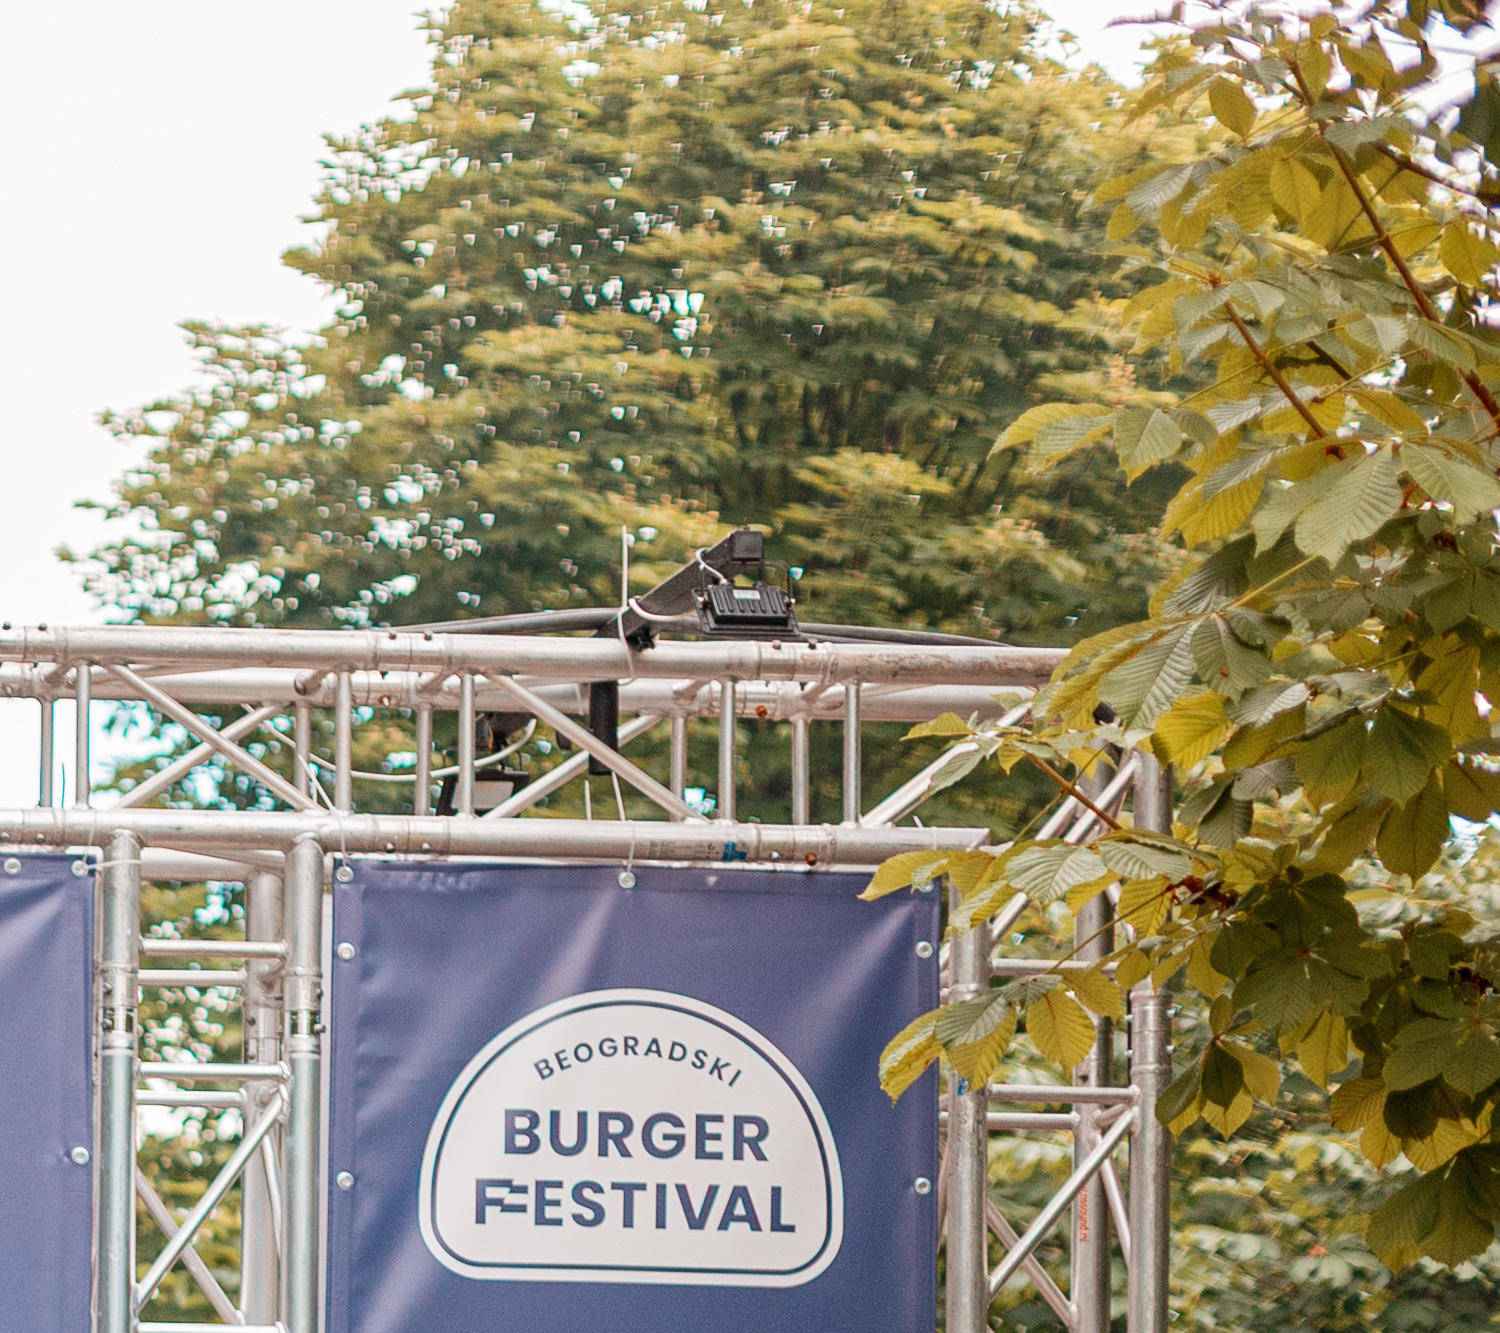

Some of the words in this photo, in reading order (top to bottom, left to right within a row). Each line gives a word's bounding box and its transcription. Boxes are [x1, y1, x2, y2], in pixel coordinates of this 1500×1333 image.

[533, 1034, 743, 1088] BEOGRADSKI
[503, 1107, 771, 1163] BURGER
[474, 1178, 798, 1234] FESTIVAL
